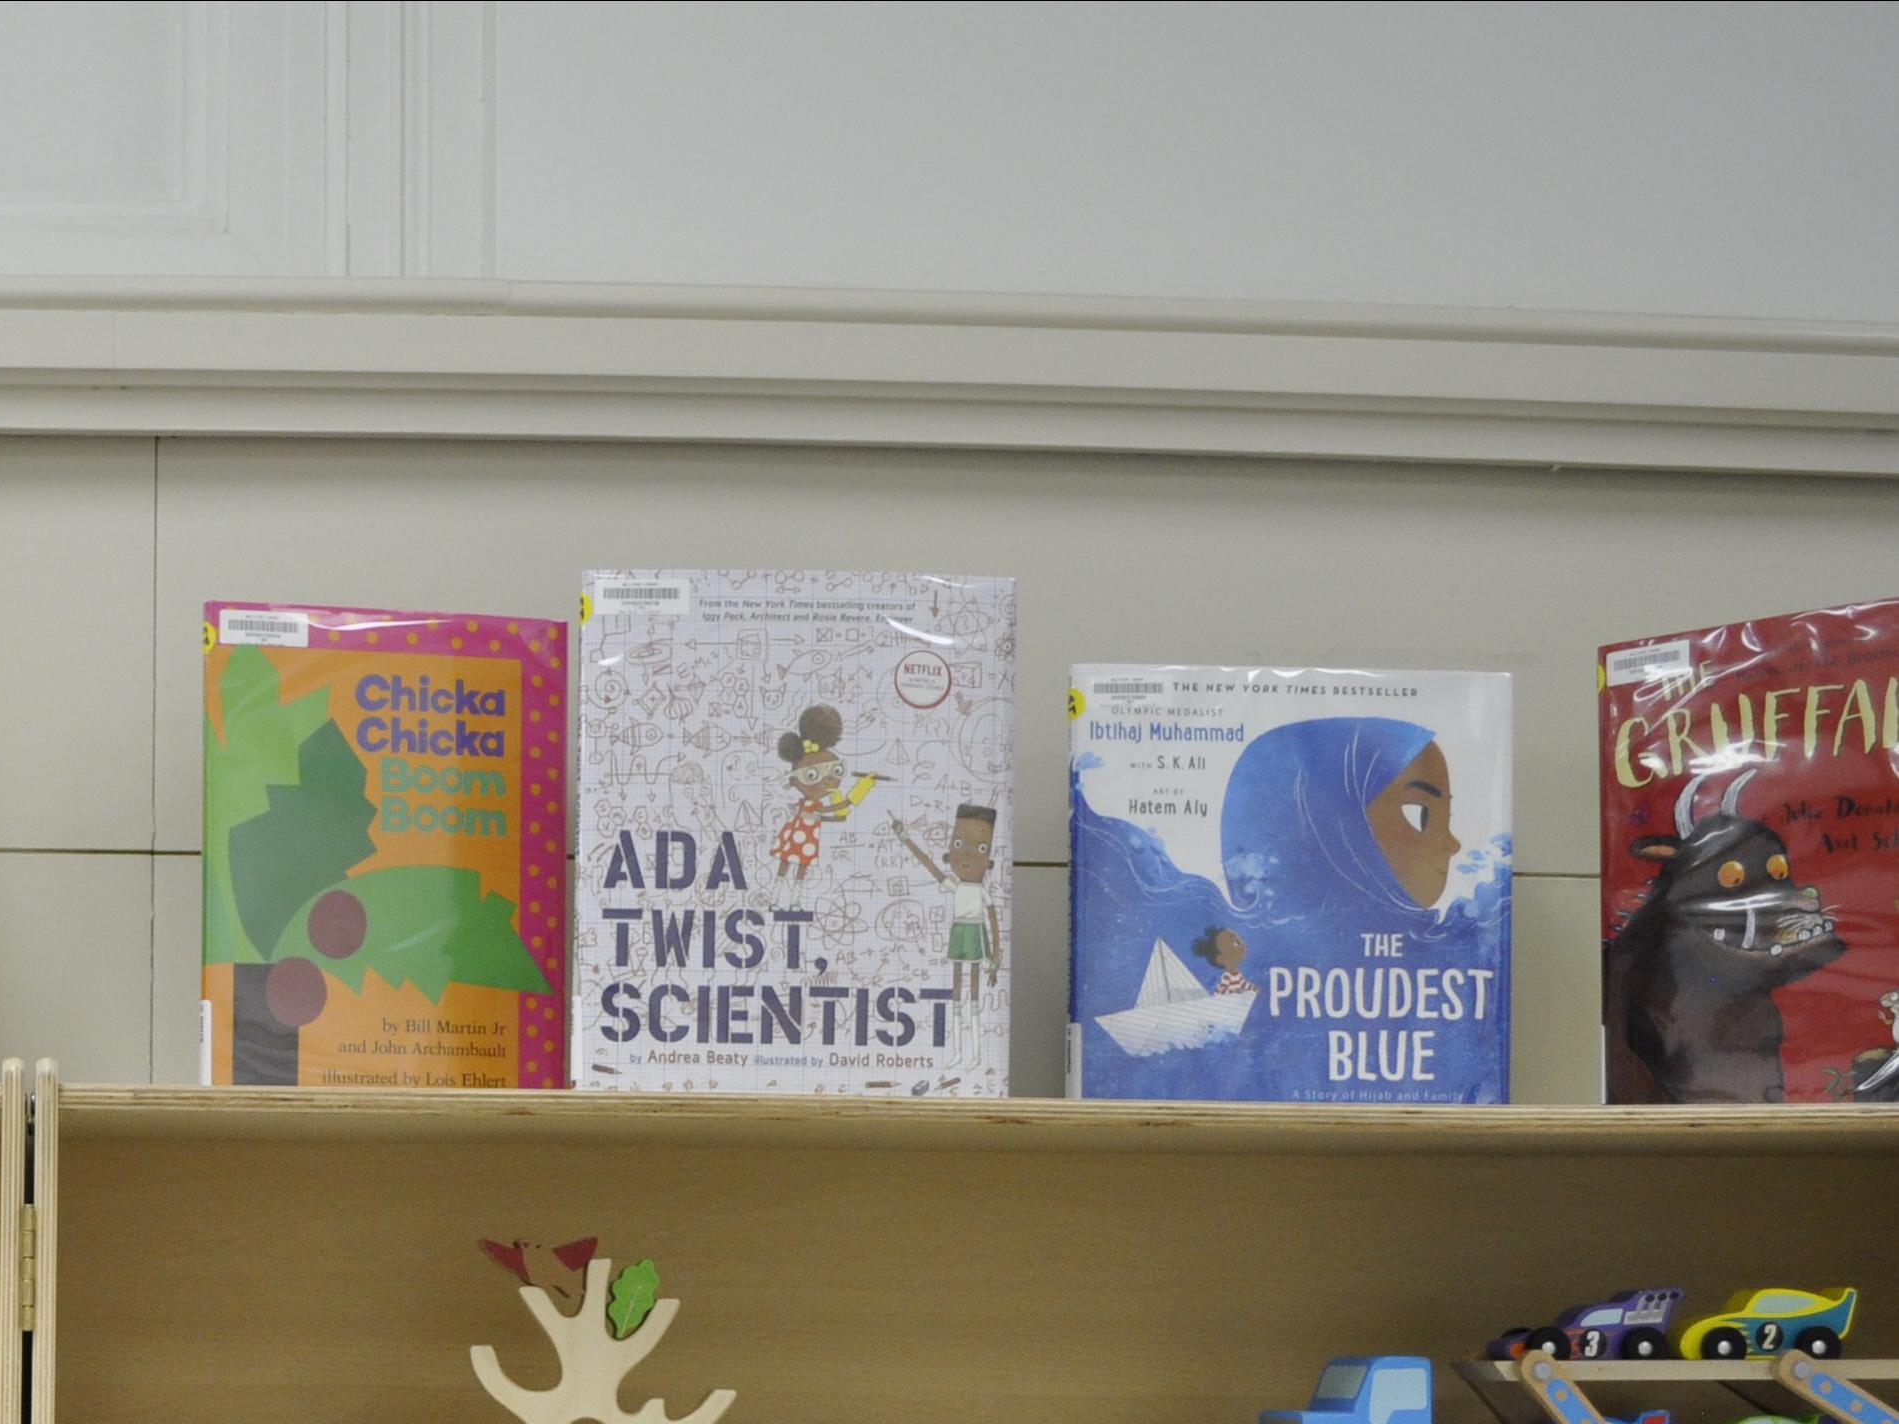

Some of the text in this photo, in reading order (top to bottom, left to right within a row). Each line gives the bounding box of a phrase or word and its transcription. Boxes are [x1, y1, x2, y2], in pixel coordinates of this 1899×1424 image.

[699, 600, 916, 611] From the New York Times bestselling creators of
[702, 612, 720, 622] Iggy
[751, 611, 790, 622] Architect
[793, 612, 810, 622] and
[812, 612, 836, 622] Rosie
[904, 663, 943, 677] NETFLIX
[355, 674, 506, 716] Chicka
[1173, 682, 1419, 698] THE NEW YORK TIMES BESTSELLER
[1111, 706, 1161, 717] OLYMPIC
[1167, 707, 1224, 717] MEDALIST
[356, 716, 505, 757] Chicka
[1090, 721, 1245, 743] Ibtihaj Muhammad
[1188, 755, 1206, 770] Ali
[381, 756, 506, 796] Boom
[381, 796, 507, 837] Boom
[1129, 799, 1208, 818] Hatem Aly
[603, 830, 747, 890] ADA
[602, 909, 829, 977] TWIST,
[1360, 933, 1404, 957] THE
[1269, 966, 1494, 1020] PROUDEST
[601, 983, 955, 1047] SCIENTIST
[383, 1018, 507, 1036] by Bill Martin Jr
[338, 1040, 507, 1058] and John Archambault
[629, 1051, 935, 1068] by Andrea Beaty illustrated by David Roberts
[1328, 1030, 1435, 1081] BLUE
[322, 1069, 507, 1088] illustrated by Lois Ehlert
[1292, 1090, 1300, 1100] A
[1304, 1090, 1338, 1102] Story
[1342, 1090, 1355, 1101] of
[1359, 1090, 1392, 1102] Hijab
[1397, 1091, 1419, 1101] and
[1584, 1331, 1600, 1357] 3
[1762, 1324, 1777, 1350] 2
